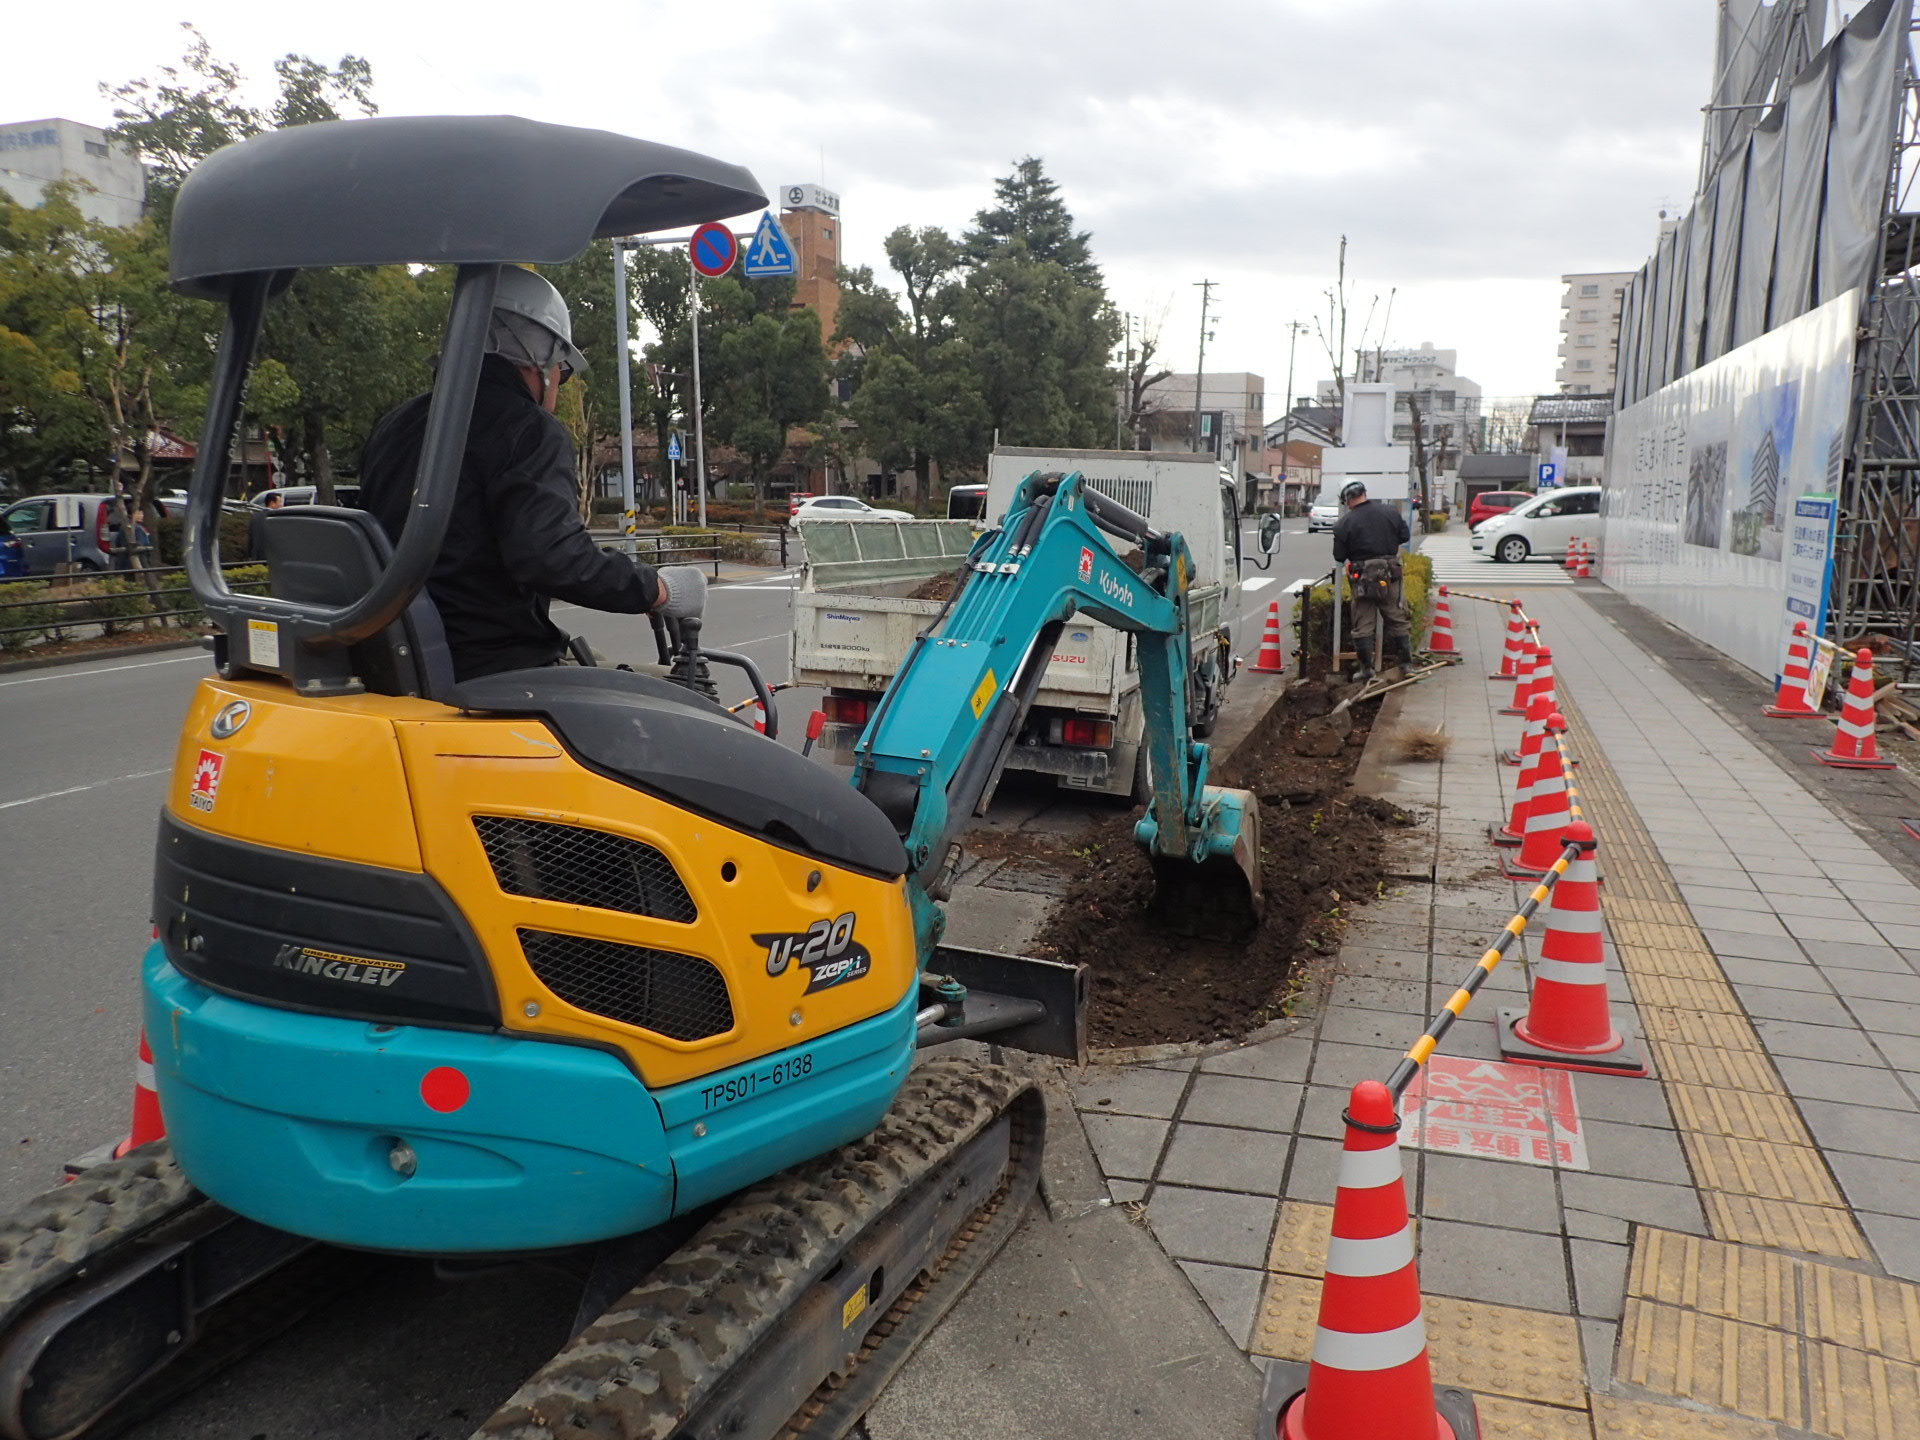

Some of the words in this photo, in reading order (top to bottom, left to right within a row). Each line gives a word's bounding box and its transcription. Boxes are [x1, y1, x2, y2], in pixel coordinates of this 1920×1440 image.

[1542, 466, 1553, 479] P
[1100, 569, 1133, 607] Kubota
[827, 613, 861, 623] ShinMaywa
[191, 793, 214, 812] TAIYO
[767, 912, 856, 977] U-20
[273, 944, 405, 987] KINGLEV
[304, 948, 338, 960] URBAN
[341, 956, 404, 969] EXCAVATOR
[846, 966, 867, 978] SERIES
[701, 1054, 812, 1110] TPS01-6138
[1444, 1102, 1536, 1129] とまれ
[1410, 1125, 1574, 1164] 自転車
